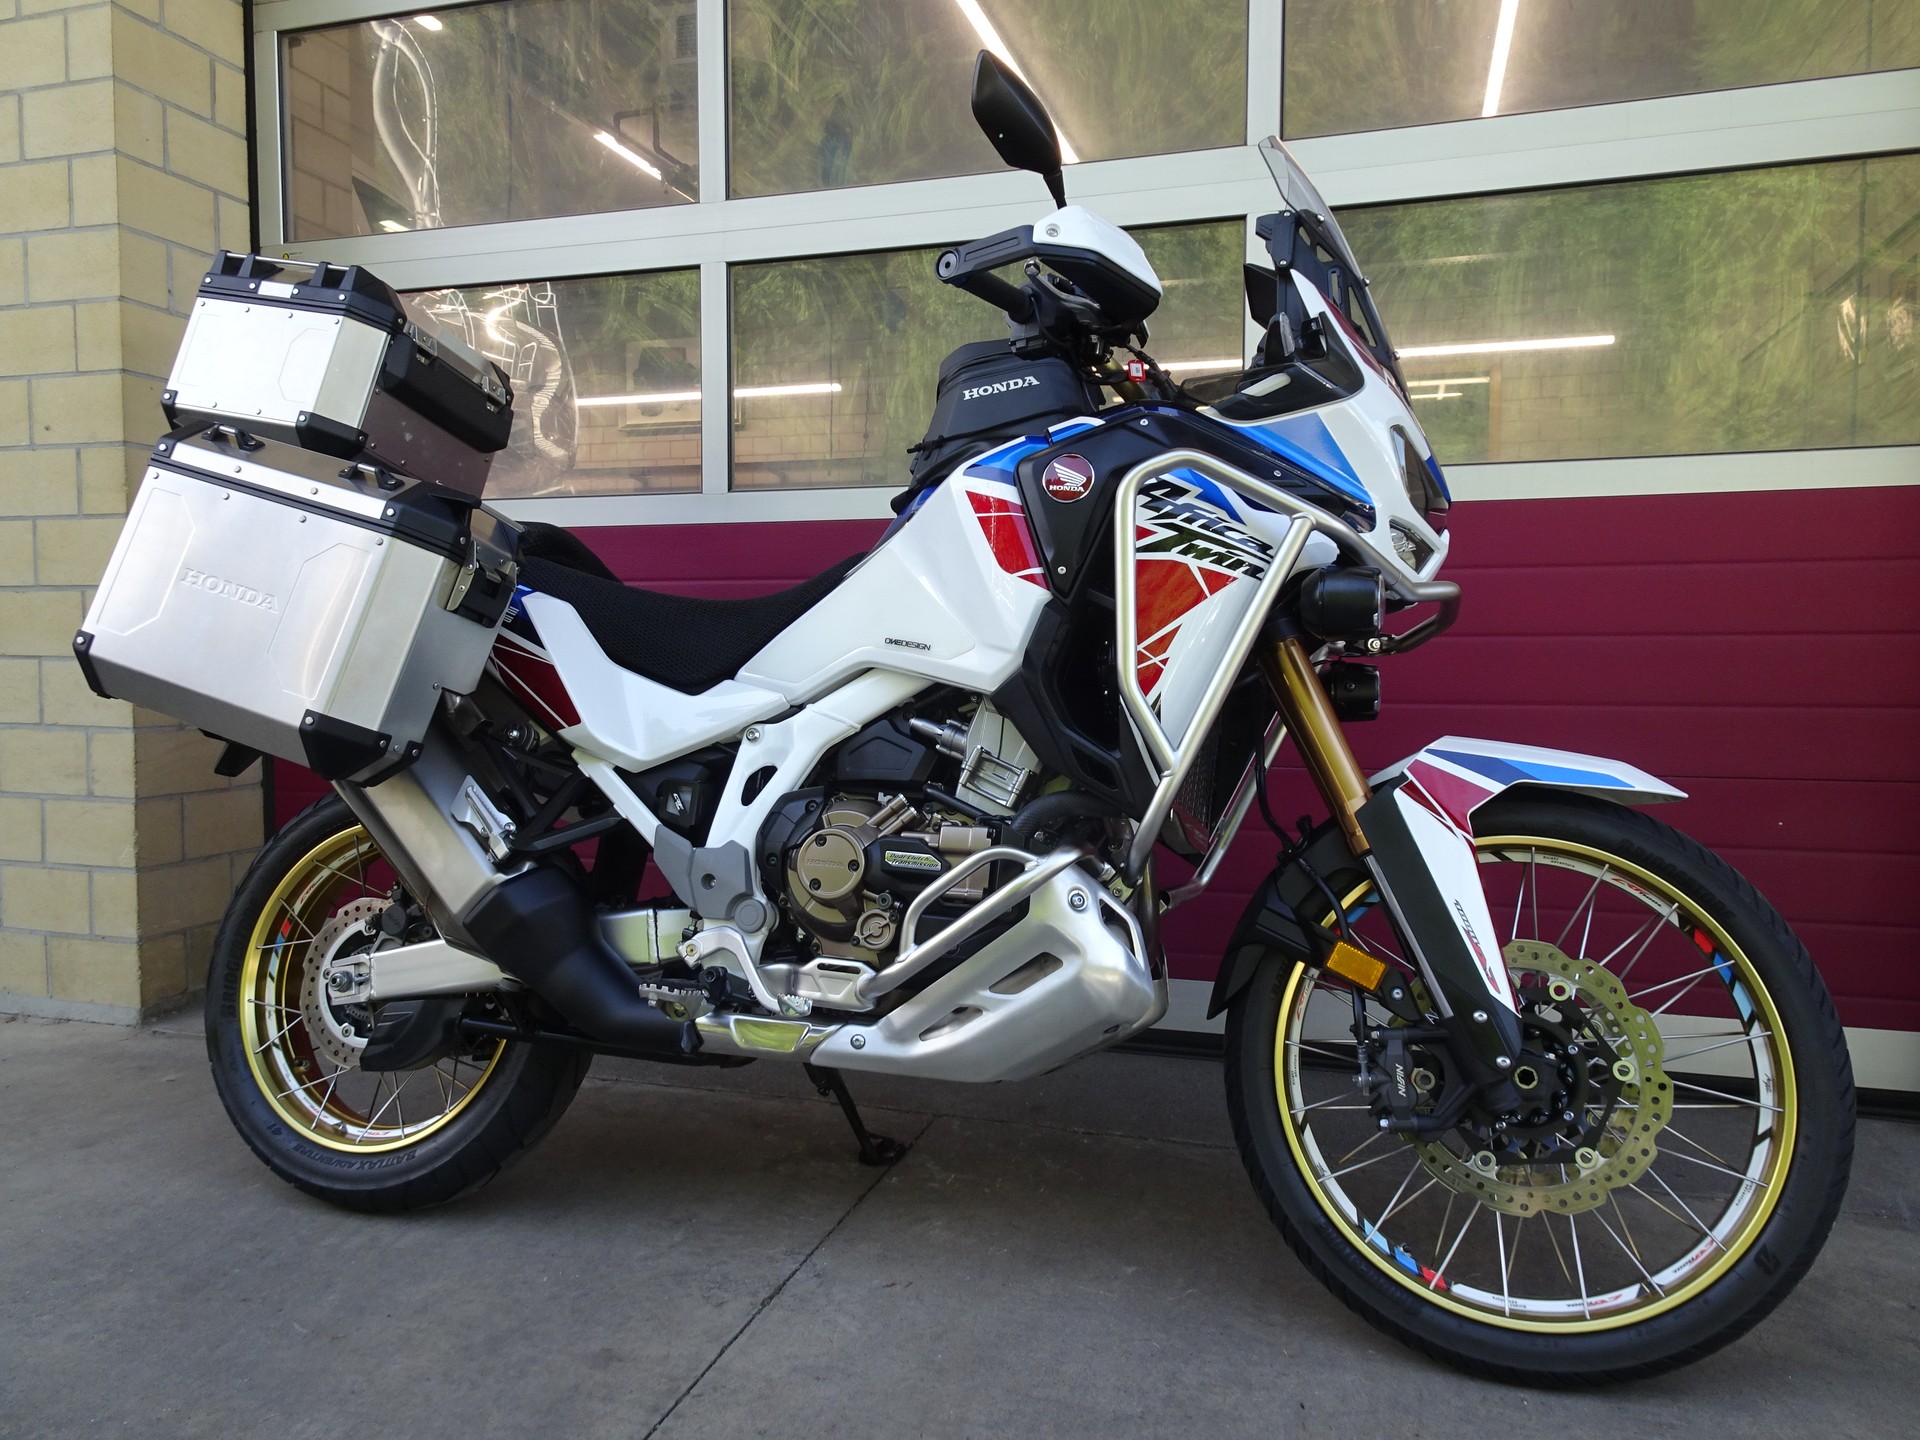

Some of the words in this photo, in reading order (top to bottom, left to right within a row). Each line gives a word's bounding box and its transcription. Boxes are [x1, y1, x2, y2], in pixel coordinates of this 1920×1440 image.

[963, 376, 1040, 400] HONDA
[1049, 484, 1085, 492] HONDA
[1136, 479, 1274, 558] Africa
[1136, 522, 1271, 581] Twin
[180, 567, 279, 614] HONDA
[807, 858, 844, 869] HONDA
[891, 859, 940, 869] Transmission
